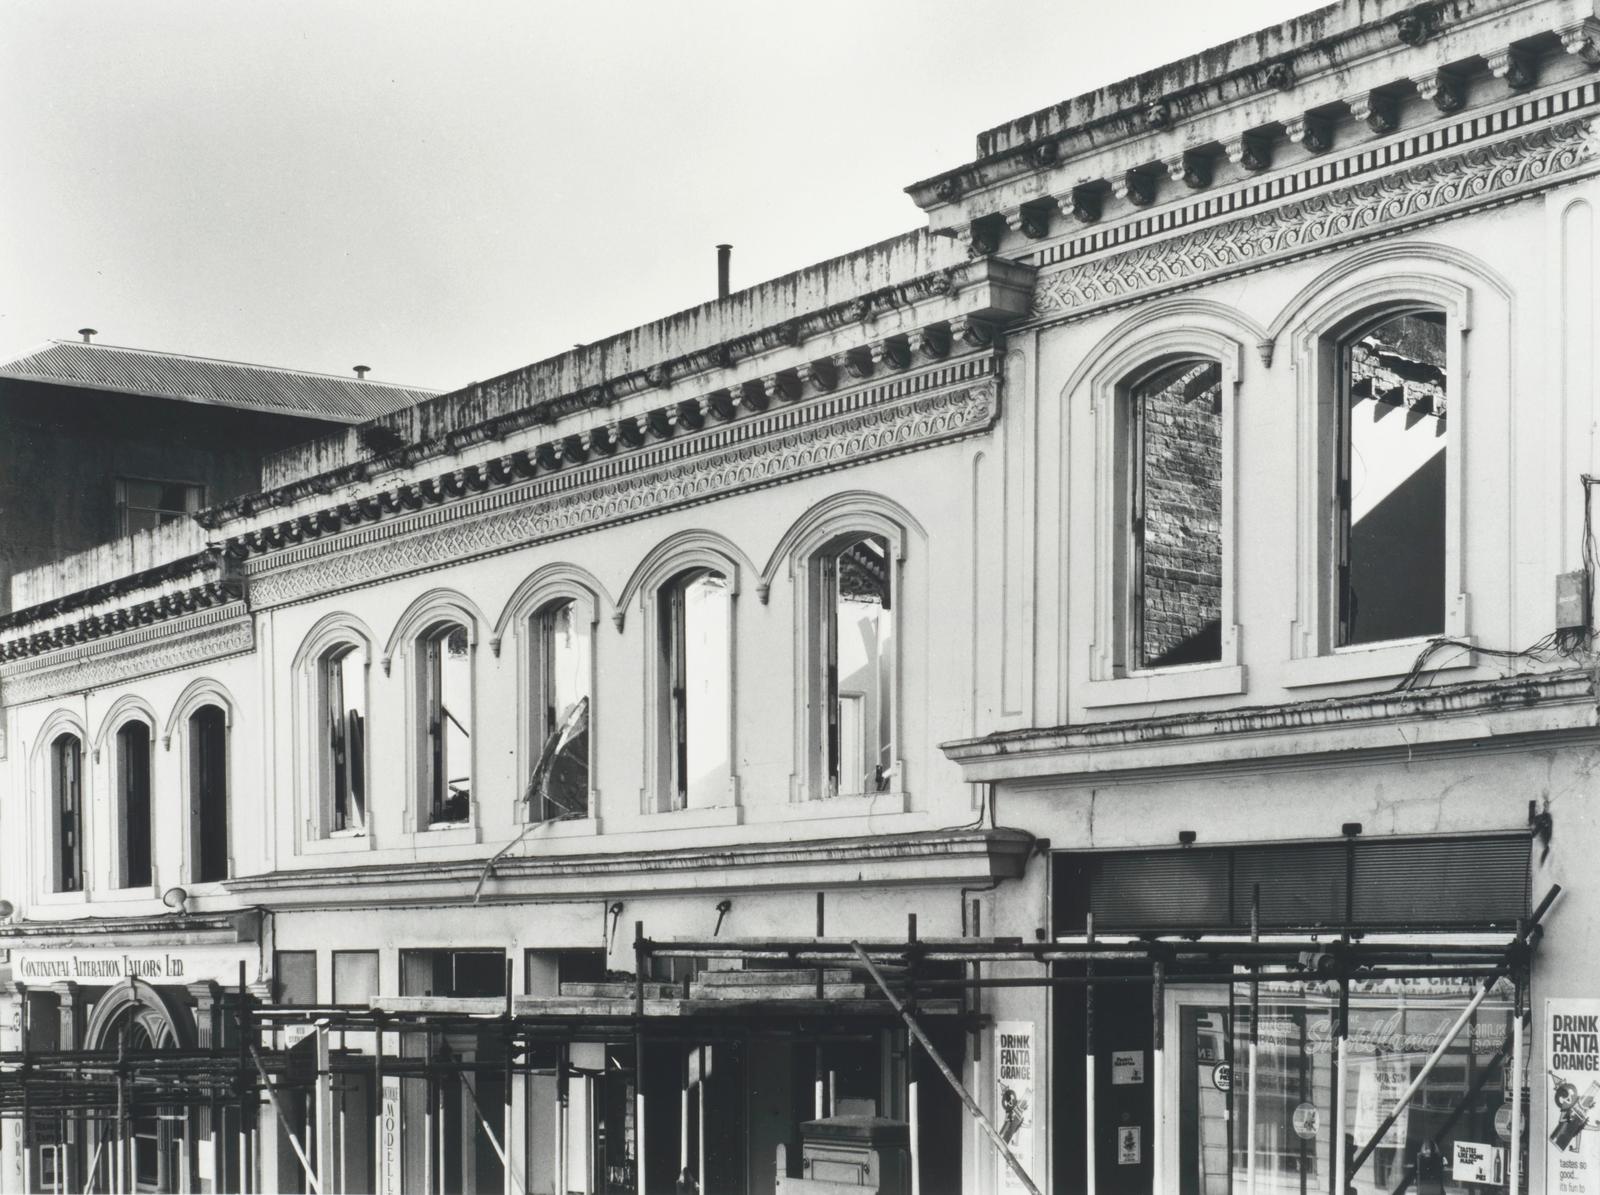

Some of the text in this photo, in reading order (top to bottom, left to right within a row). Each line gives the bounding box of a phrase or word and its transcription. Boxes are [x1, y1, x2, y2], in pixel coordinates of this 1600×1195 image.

[1467, 1023, 1507, 1040] MILK
[1553, 1015, 1598, 1032] DRINK
[1001, 1034, 1030, 1048] DRINK
[1472, 1039, 1504, 1055] BAR
[1553, 1033, 1599, 1053] FANTA
[1001, 1049, 1030, 1065] FANTA
[1553, 1053, 1599, 1071] ORANGE
[1001, 1065, 1030, 1080] ORANGE
[1560, 1159, 1587, 1170] tastes so
